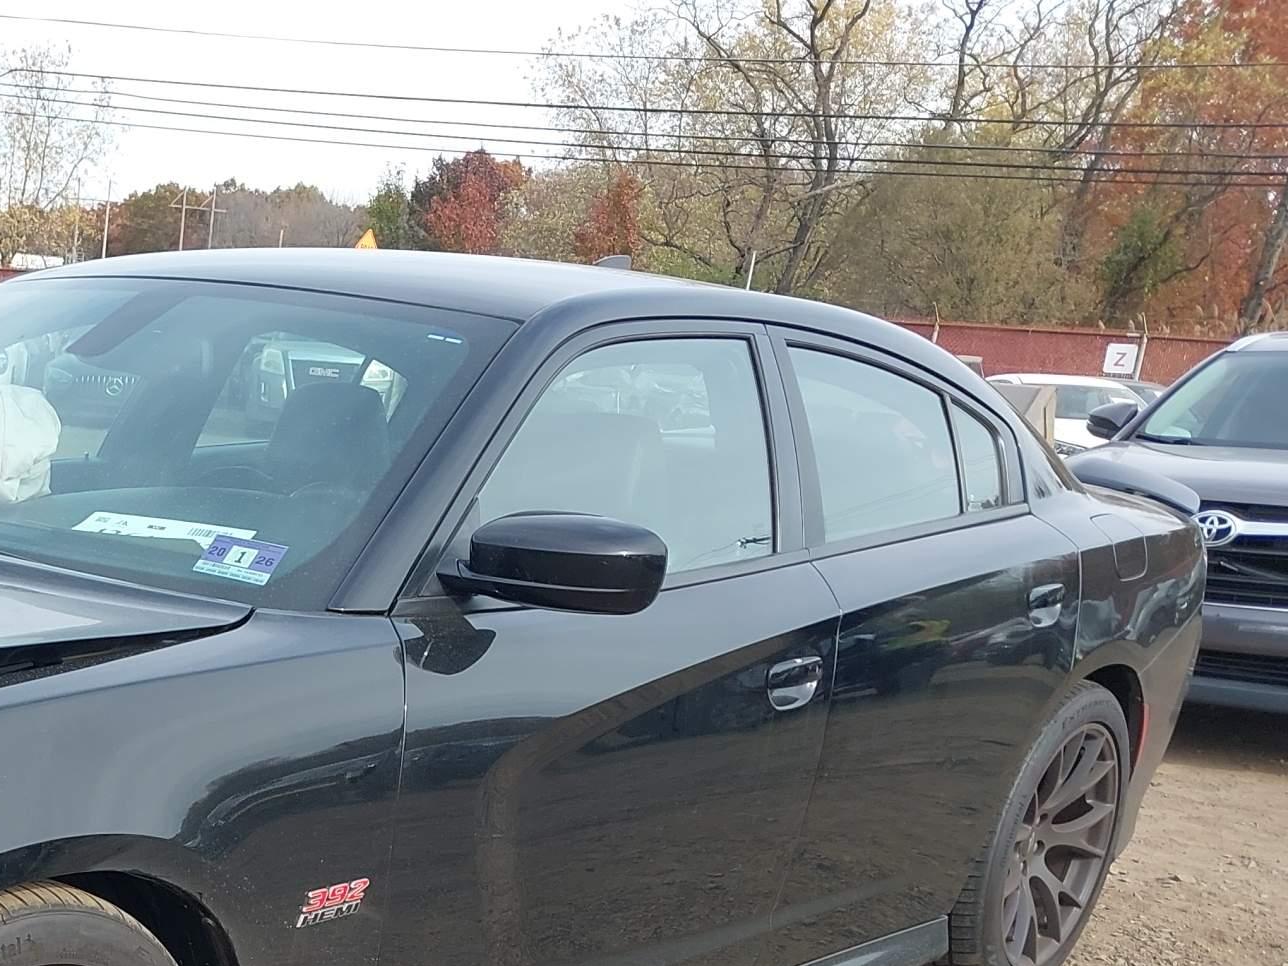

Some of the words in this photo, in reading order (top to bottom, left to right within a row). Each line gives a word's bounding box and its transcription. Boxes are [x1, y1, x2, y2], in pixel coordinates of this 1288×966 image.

[1113, 352, 1127, 367] Z
[208, 546, 226, 557] 20
[234, 551, 247, 564] 1
[255, 556, 275, 567] 26
[303, 878, 370, 912] 392
[296, 901, 361, 928] HEMI
